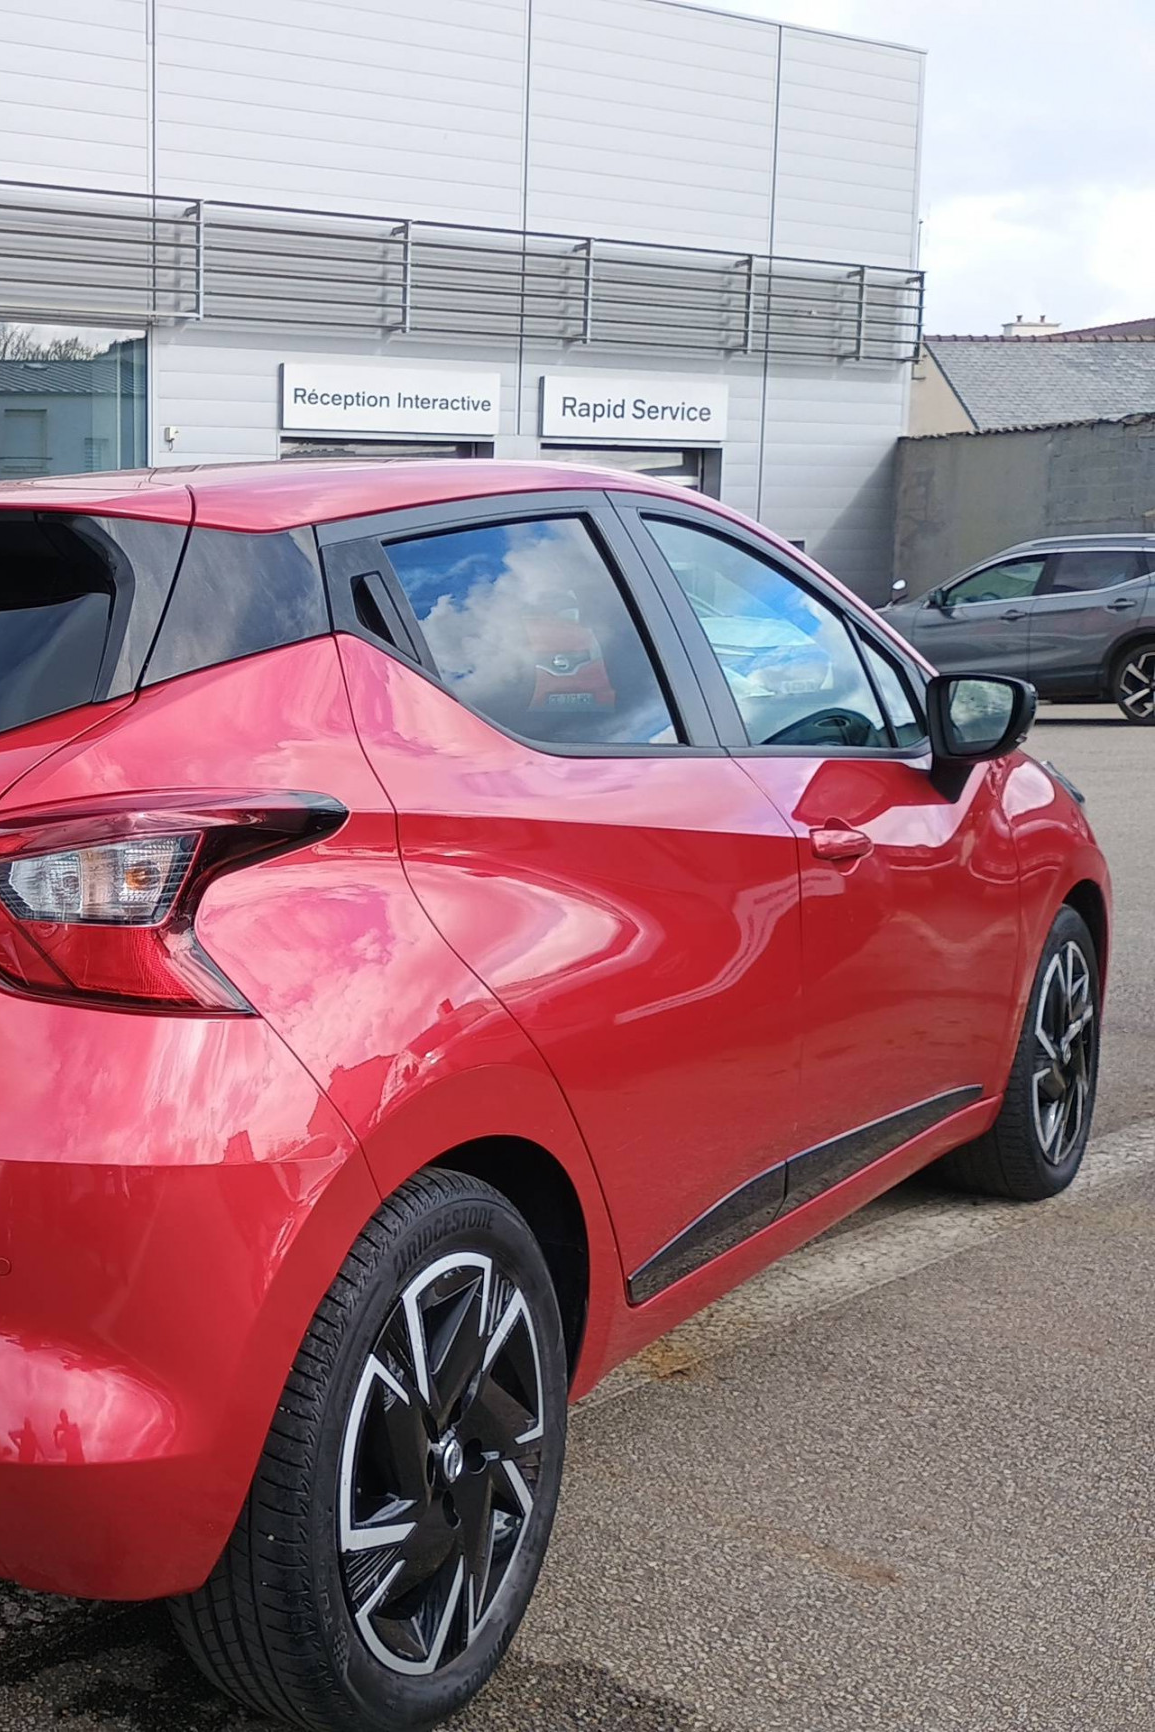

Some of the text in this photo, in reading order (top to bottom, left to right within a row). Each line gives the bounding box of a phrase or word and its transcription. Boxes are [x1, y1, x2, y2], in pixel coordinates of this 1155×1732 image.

[293, 387, 492, 412] Réception Interactive
[561, 396, 711, 423] Rapid Service
